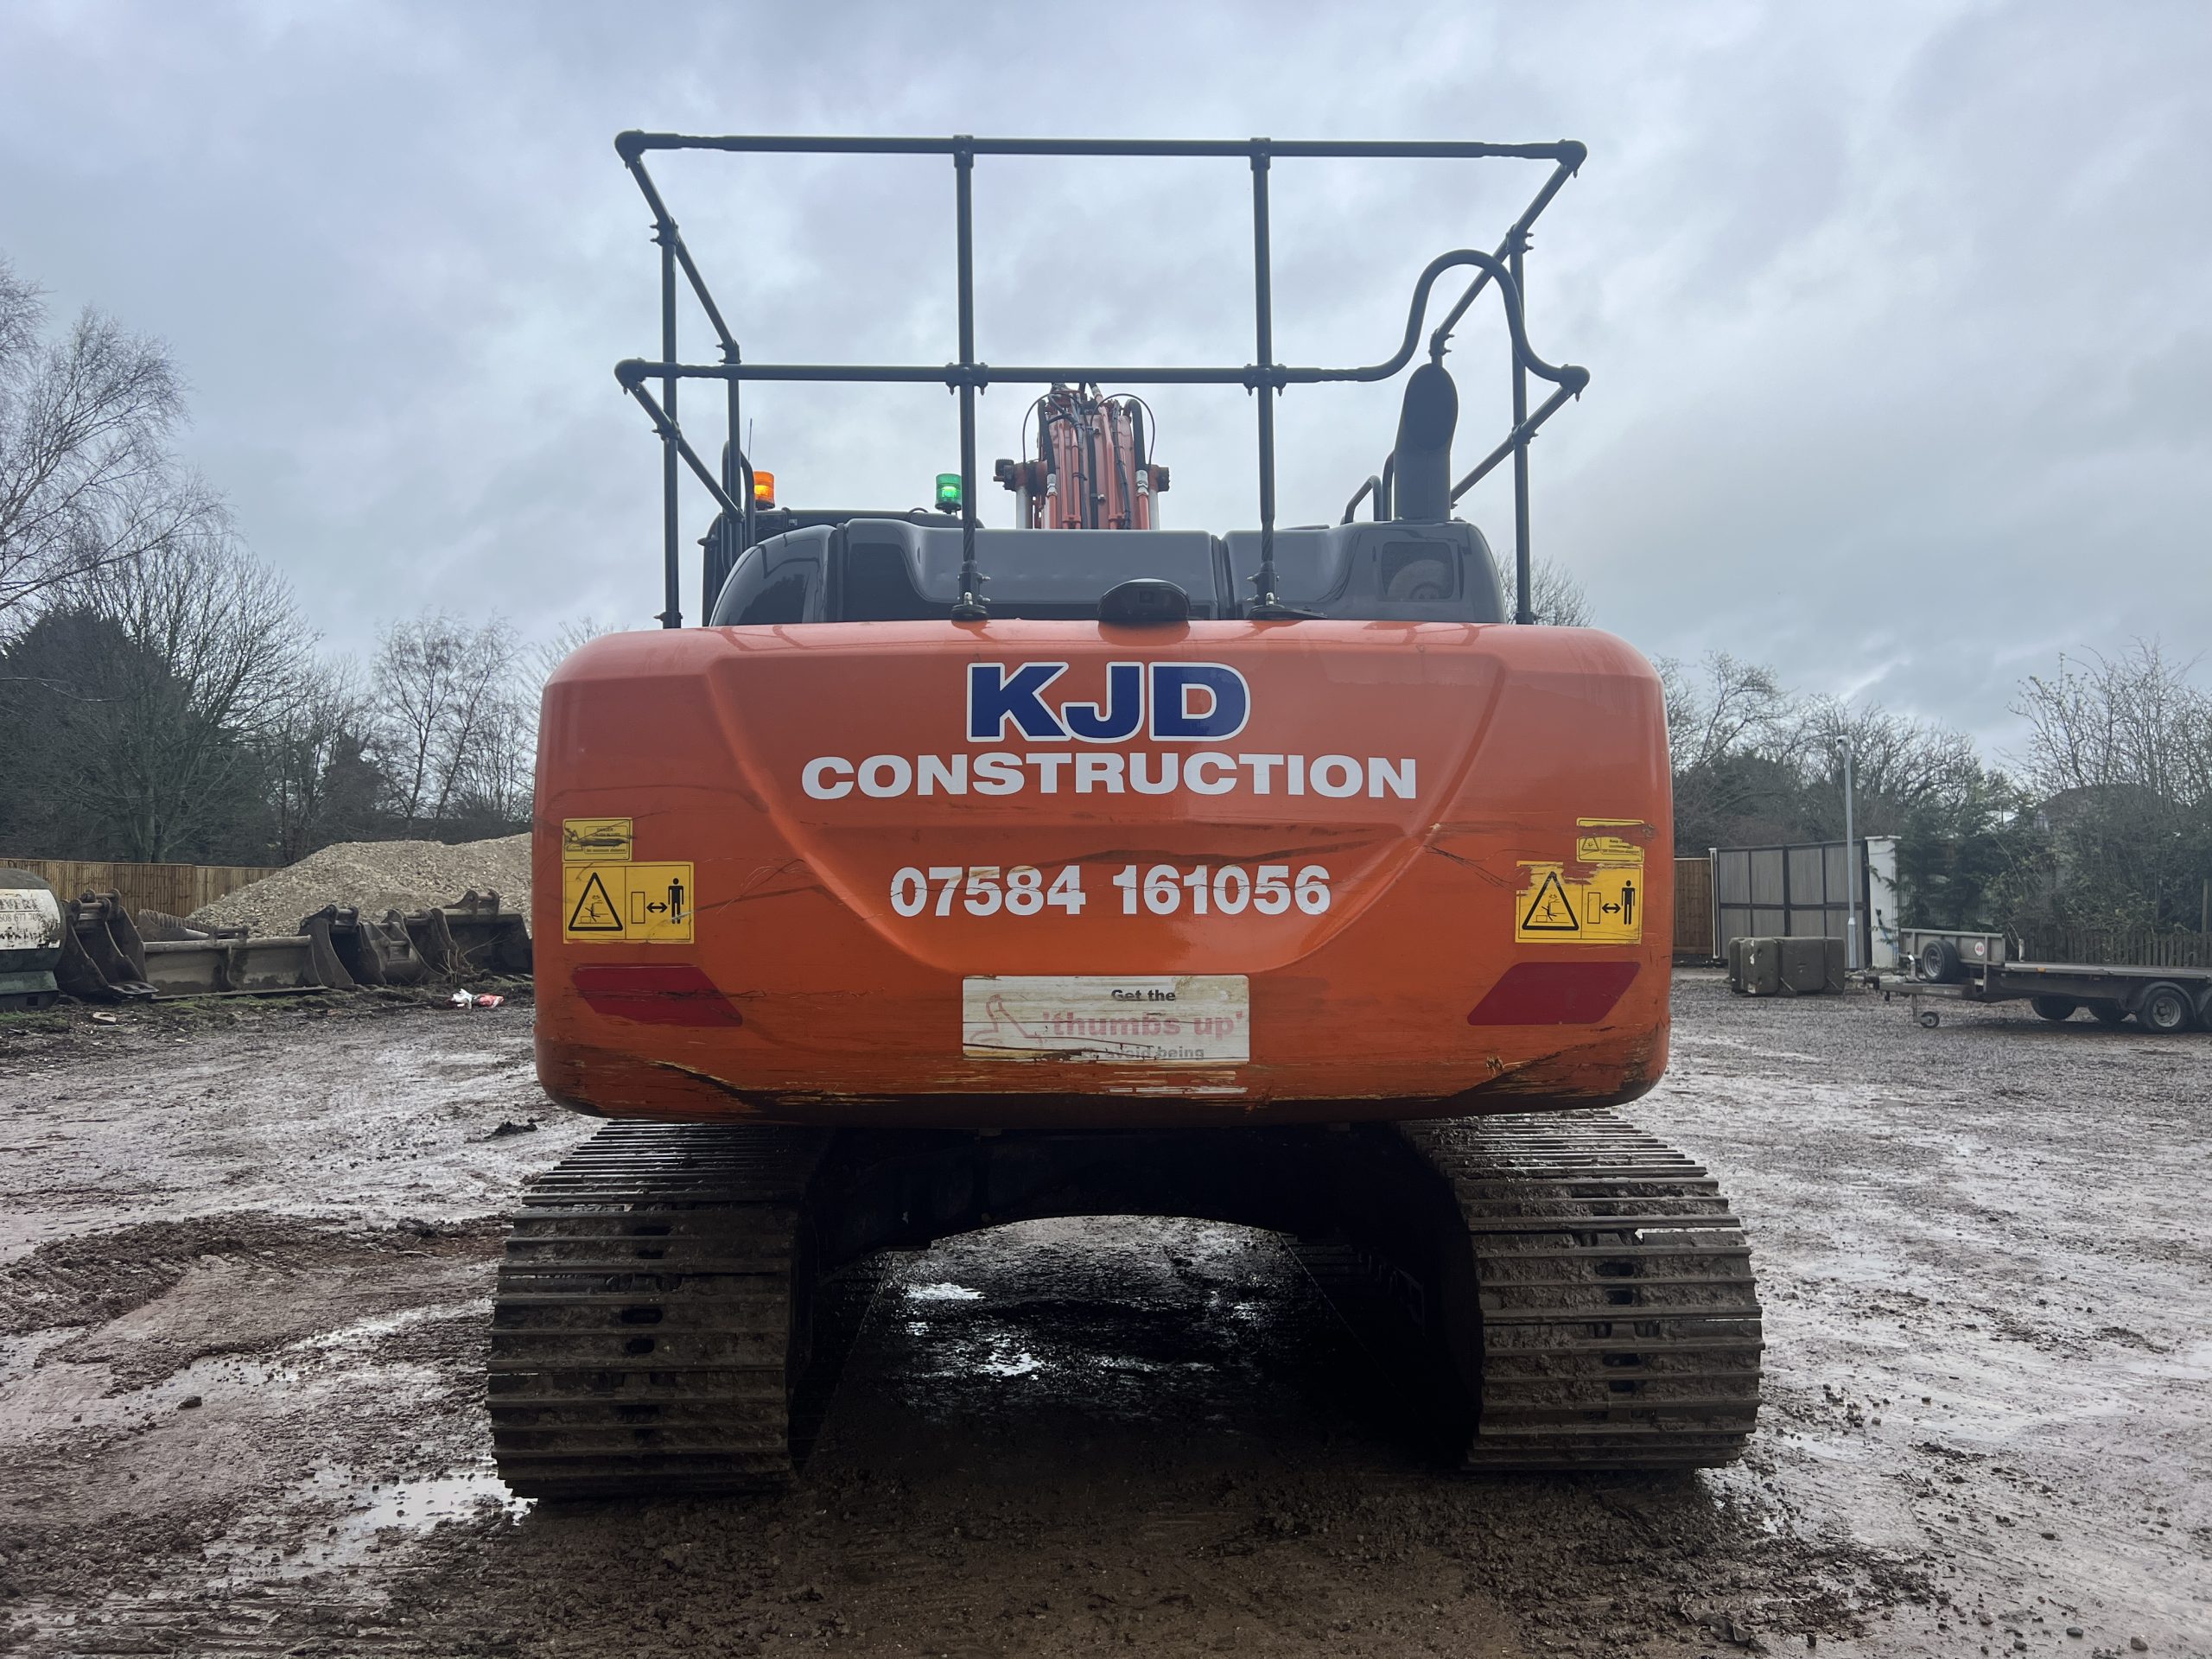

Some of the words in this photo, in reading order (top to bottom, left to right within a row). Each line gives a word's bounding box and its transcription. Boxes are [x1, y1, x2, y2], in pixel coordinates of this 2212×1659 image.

[966, 661, 1251, 744] KJD
[802, 752, 1417, 800] CONSTRUCTION
[890, 865, 1086, 918] 07584
[1113, 864, 1331, 916] 161056
[1110, 988, 1141, 1001] Get
[1147, 988, 1176, 1001] the
[1157, 1046, 1205, 1060] being
